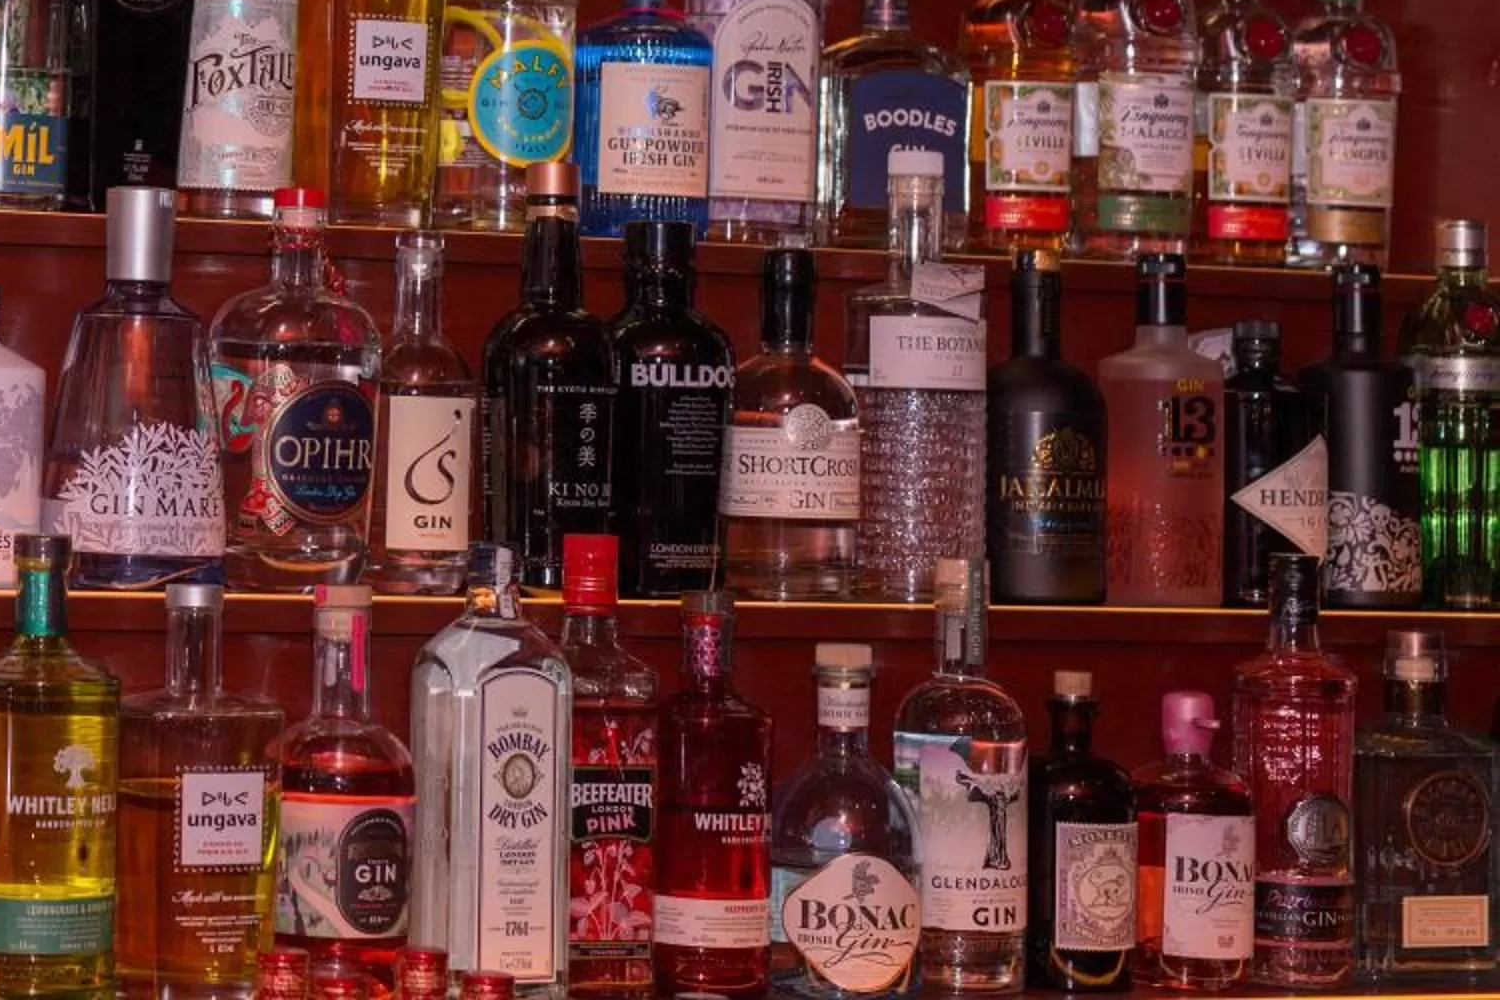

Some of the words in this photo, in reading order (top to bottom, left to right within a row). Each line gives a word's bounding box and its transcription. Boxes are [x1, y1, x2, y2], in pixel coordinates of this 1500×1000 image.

[359, 53, 422, 72] ungava
[765, 60, 783, 114] IRISH
[863, 107, 957, 138] BOODLES
[13, 163, 35, 176] GIN
[666, 153, 698, 169] GIN
[1176, 378, 1205, 394] GIN
[1164, 395, 1216, 446] 13
[274, 435, 373, 471] OPIHR
[90, 493, 144, 518] GIN
[789, 489, 826, 511] GIN
[413, 514, 454, 530] GIN
[486, 733, 550, 763] BOMBAY
[6, 794, 88, 815] WHITLEY
[570, 783, 654, 810] BEEFEATER
[186, 810, 257, 832] ungava
[487, 804, 518, 830] DRY
[520, 804, 549, 829] GIN
[591, 805, 634, 815] LONDON
[585, 813, 636, 834] PINK
[695, 812, 761, 832] WHITLEY
[354, 863, 397, 884] GIN
[799, 897, 916, 931] BONAC
[972, 905, 1018, 927] GIN
[1303, 910, 1338, 928] GIN
